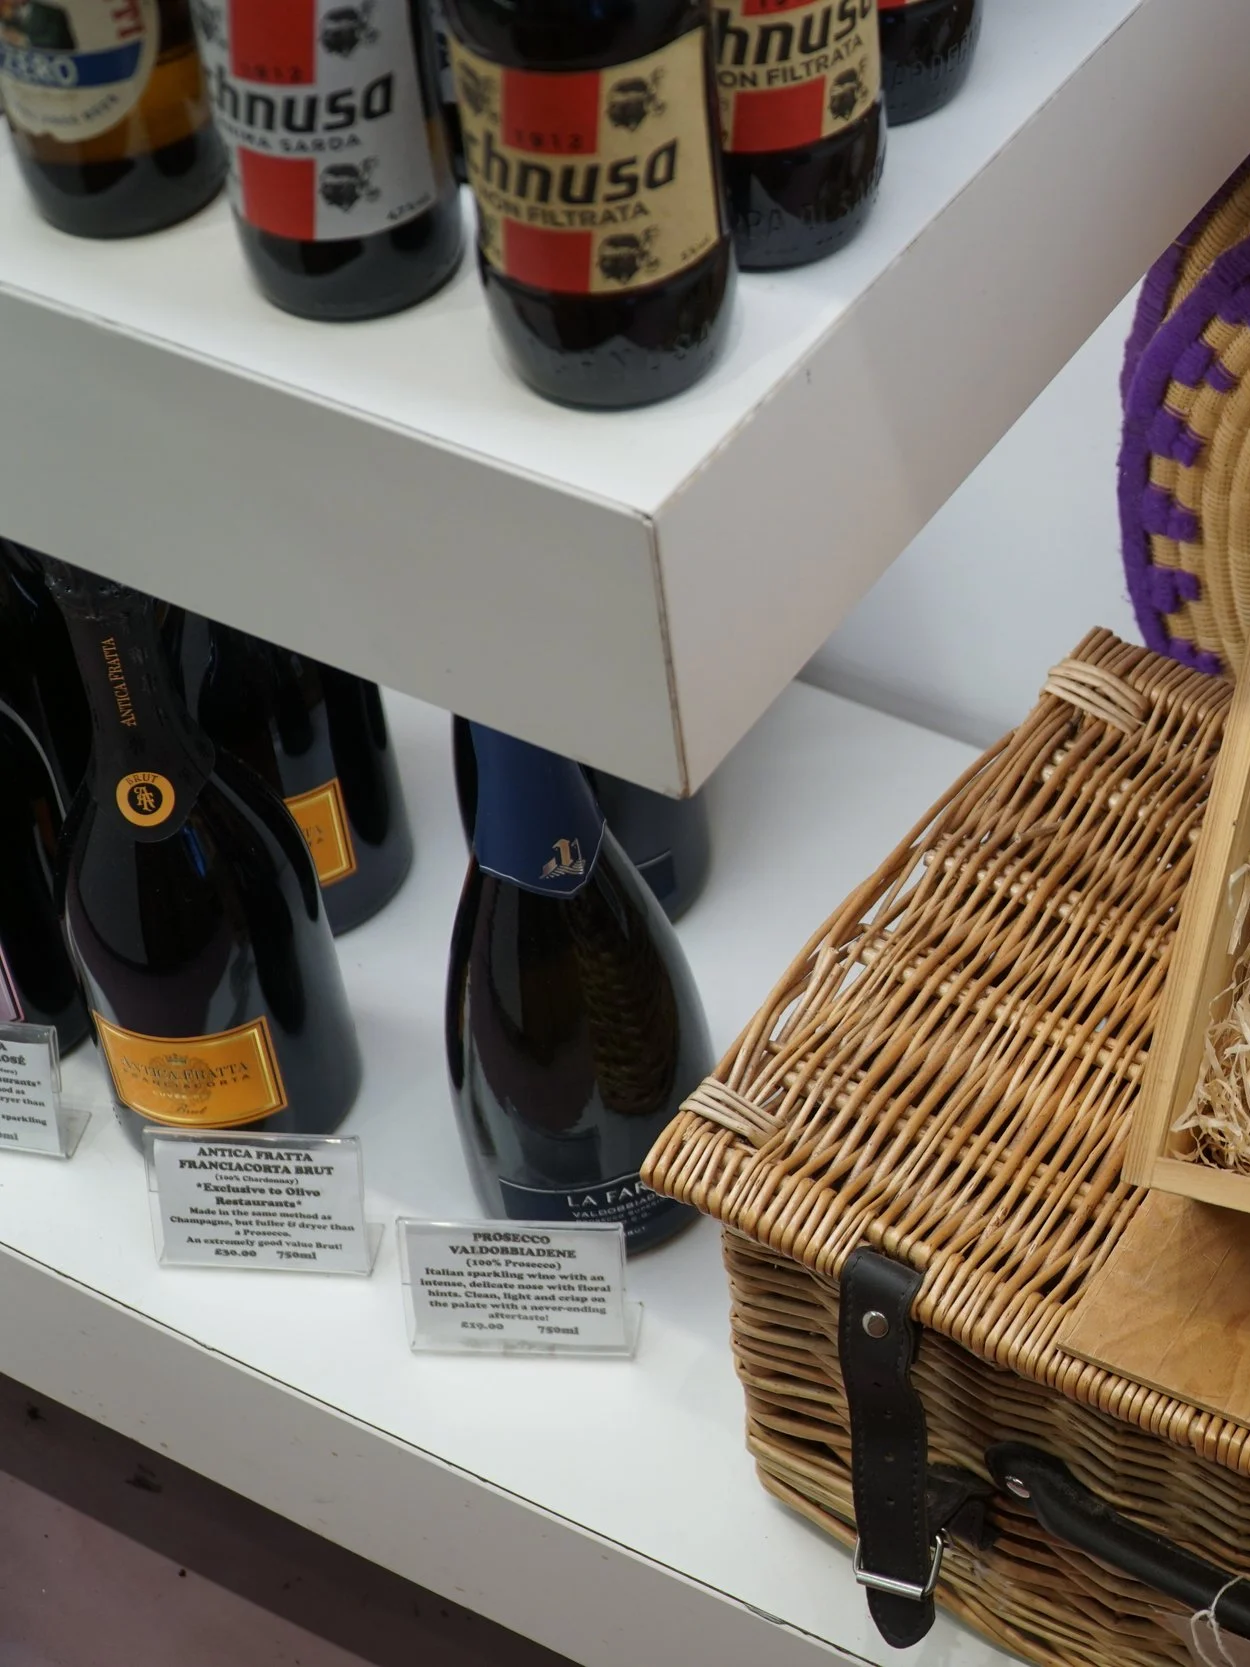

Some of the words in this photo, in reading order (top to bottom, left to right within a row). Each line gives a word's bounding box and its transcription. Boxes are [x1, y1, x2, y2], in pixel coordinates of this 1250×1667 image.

[717, 69, 758, 88] ON
[764, 36, 864, 87] FILTRATA
[278, 133, 363, 153] SARDA
[526, 200, 649, 228] FILTRATA
[101, 636, 124, 682] FRATTA
[112, 682, 138, 728] ANTICA
[126, 773, 159, 786] BRUT
[121, 1056, 178, 1080] ANTICA
[183, 1061, 249, 1082] FRATTA
[22, 1098, 46, 1107] than
[1, 1113, 47, 1126] sparkling
[197, 1146, 253, 1159] ANTICA
[256, 1150, 313, 1162] FRATTA
[179, 1159, 292, 1175] FRANCIACORTA
[295, 1165, 334, 1176] BRUT
[242, 1176, 299, 1185] Chardonnay)
[268, 1186, 281, 1195] to
[285, 1186, 321, 1198] Olivo
[566, 1195, 598, 1208] LA
[571, 1192, 657, 1219] VALDOBBIAD
[189, 1207, 218, 1216] Made
[219, 1207, 230, 1216] in
[231, 1208, 248, 1217] the
[251, 1210, 278, 1218] same
[280, 1210, 319, 1220] method
[170, 1215, 233, 1228] Champagne,
[235, 1218, 253, 1227] but
[255, 1218, 286, 1228] fuller
[287, 1220, 297, 1228] &
[298, 1221, 328, 1232] dryer
[330, 1223, 355, 1232] than
[242, 1229, 292, 1238] Prosecco.
[472, 1232, 551, 1245] PROSECCO
[186, 1236, 202, 1244] An
[203, 1237, 255, 1248] extremely
[257, 1239, 283, 1248] good
[285, 1240, 314, 1249] value
[276, 1250, 318, 1261] 750ml
[449, 1245, 577, 1259] VALDOBBIADENE
[466, 1258, 503, 1267] (100%
[504, 1259, 562, 1271] Prosecco)
[425, 1267, 465, 1277] Italian
[467, 1268, 525, 1281] sparkling
[526, 1271, 557, 1281] wine
[558, 1272, 589, 1282] with
[420, 1278, 467, 1289] intense,
[469, 1280, 516, 1290] delicate
[518, 1283, 545, 1291] nose
[547, 1283, 576, 1292] with
[577, 1283, 611, 1293] floral
[428, 1289, 462, 1298] hints.
[464, 1290, 501, 1301] Clean,
[503, 1291, 532, 1302] light
[533, 1294, 556, 1302] and
[558, 1294, 588, 1304] crisp
[590, 1296, 606, 1304] on
[429, 1300, 449, 1308] the
[451, 1301, 488, 1311] palate
[490, 1302, 519, 1311] with
[530, 1304, 607, 1315] never-ending
[488, 1311, 549, 1322] aftertaste!
